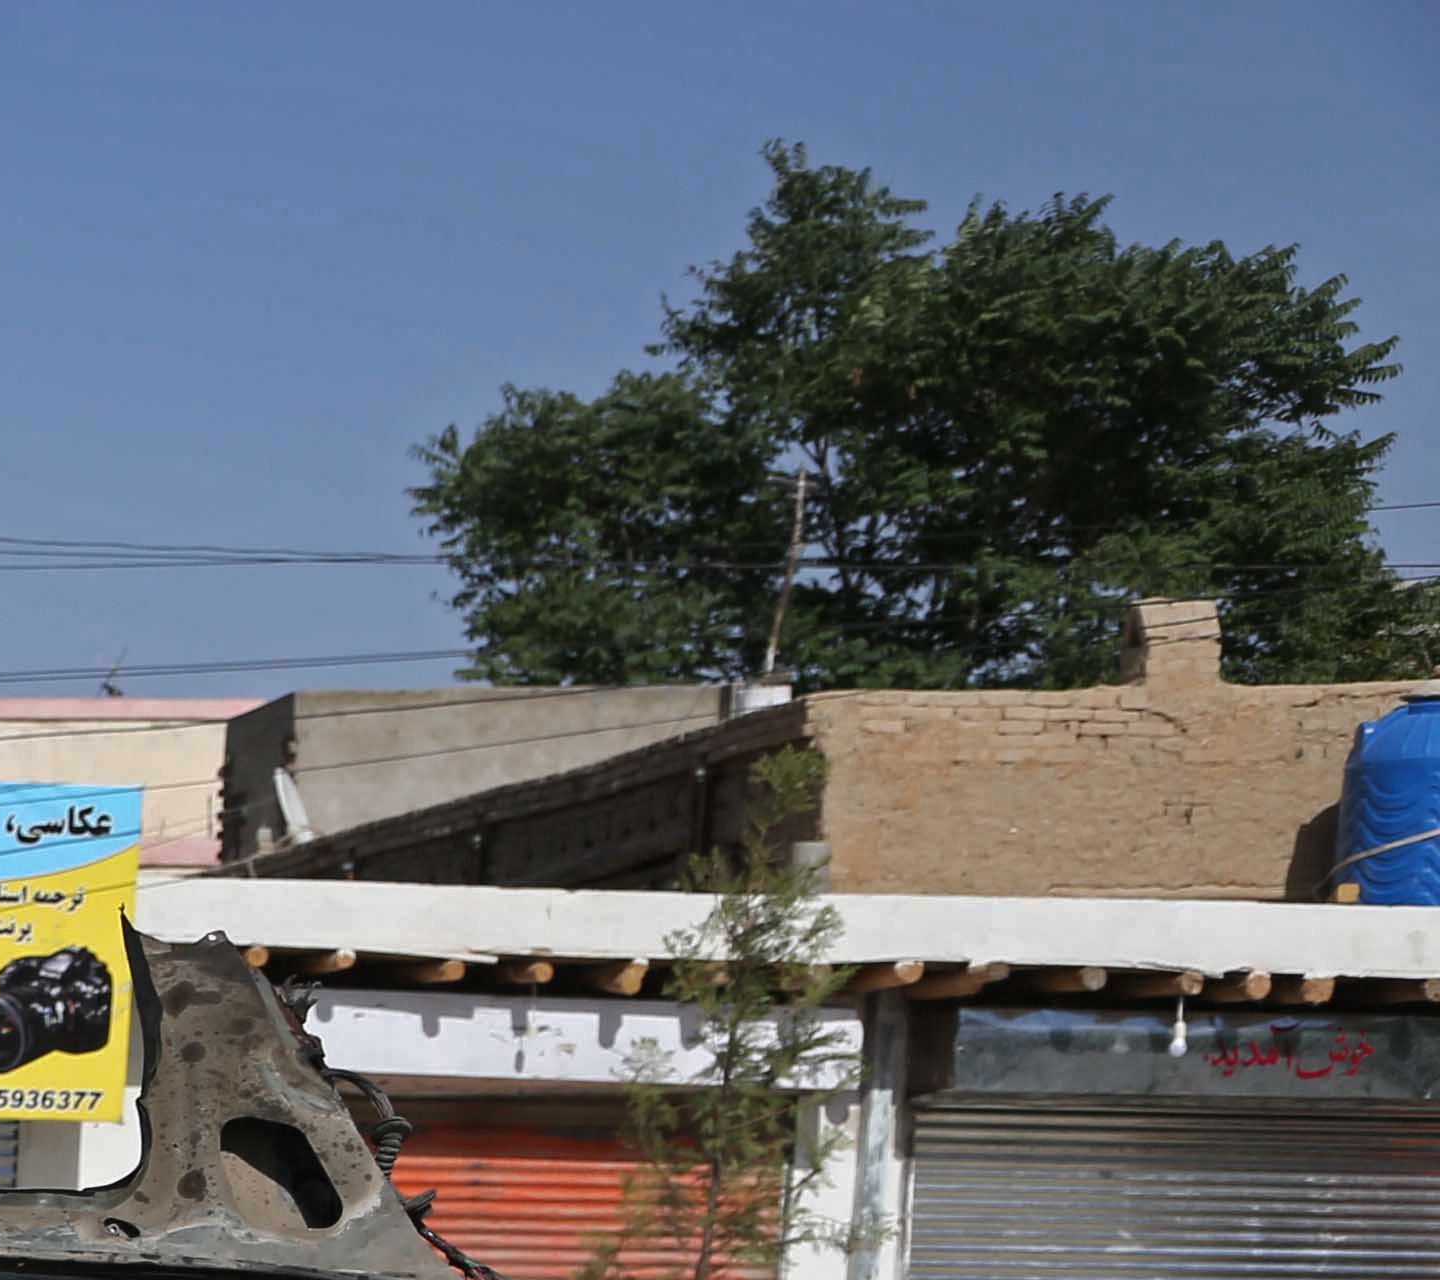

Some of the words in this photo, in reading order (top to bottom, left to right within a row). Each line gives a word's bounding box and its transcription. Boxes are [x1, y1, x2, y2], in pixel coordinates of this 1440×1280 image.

[7, 804, 112, 843] عکاسی،
[32, 886, 86, 911] ترجمه
[1208, 1019, 1300, 1078] آمدید
[1295, 1026, 1378, 1080] خوش
